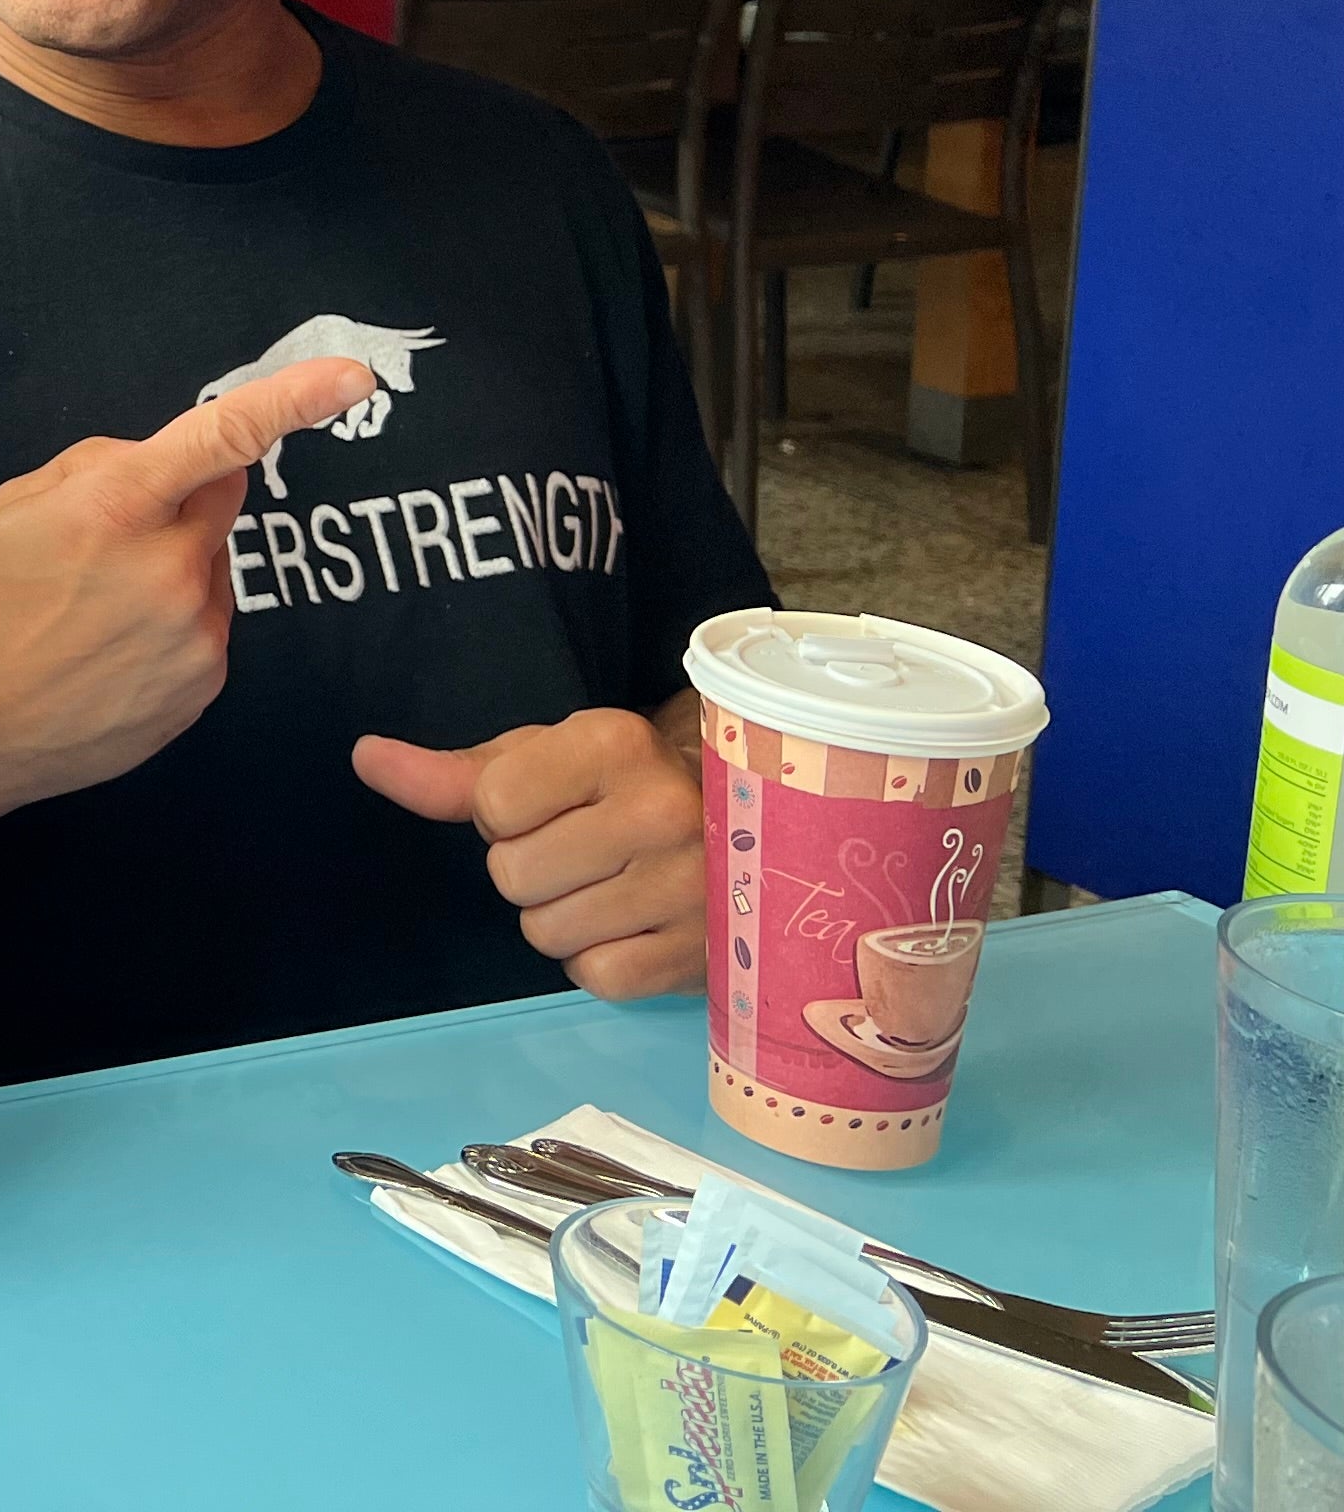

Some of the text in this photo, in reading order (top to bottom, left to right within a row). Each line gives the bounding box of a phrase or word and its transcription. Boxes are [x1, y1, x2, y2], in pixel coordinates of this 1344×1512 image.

[760, 867, 857, 965] Tea
[752, 1425, 766, 1451] THE
[756, 1453, 768, 1467] IN
[757, 1468, 772, 1501] MADE
